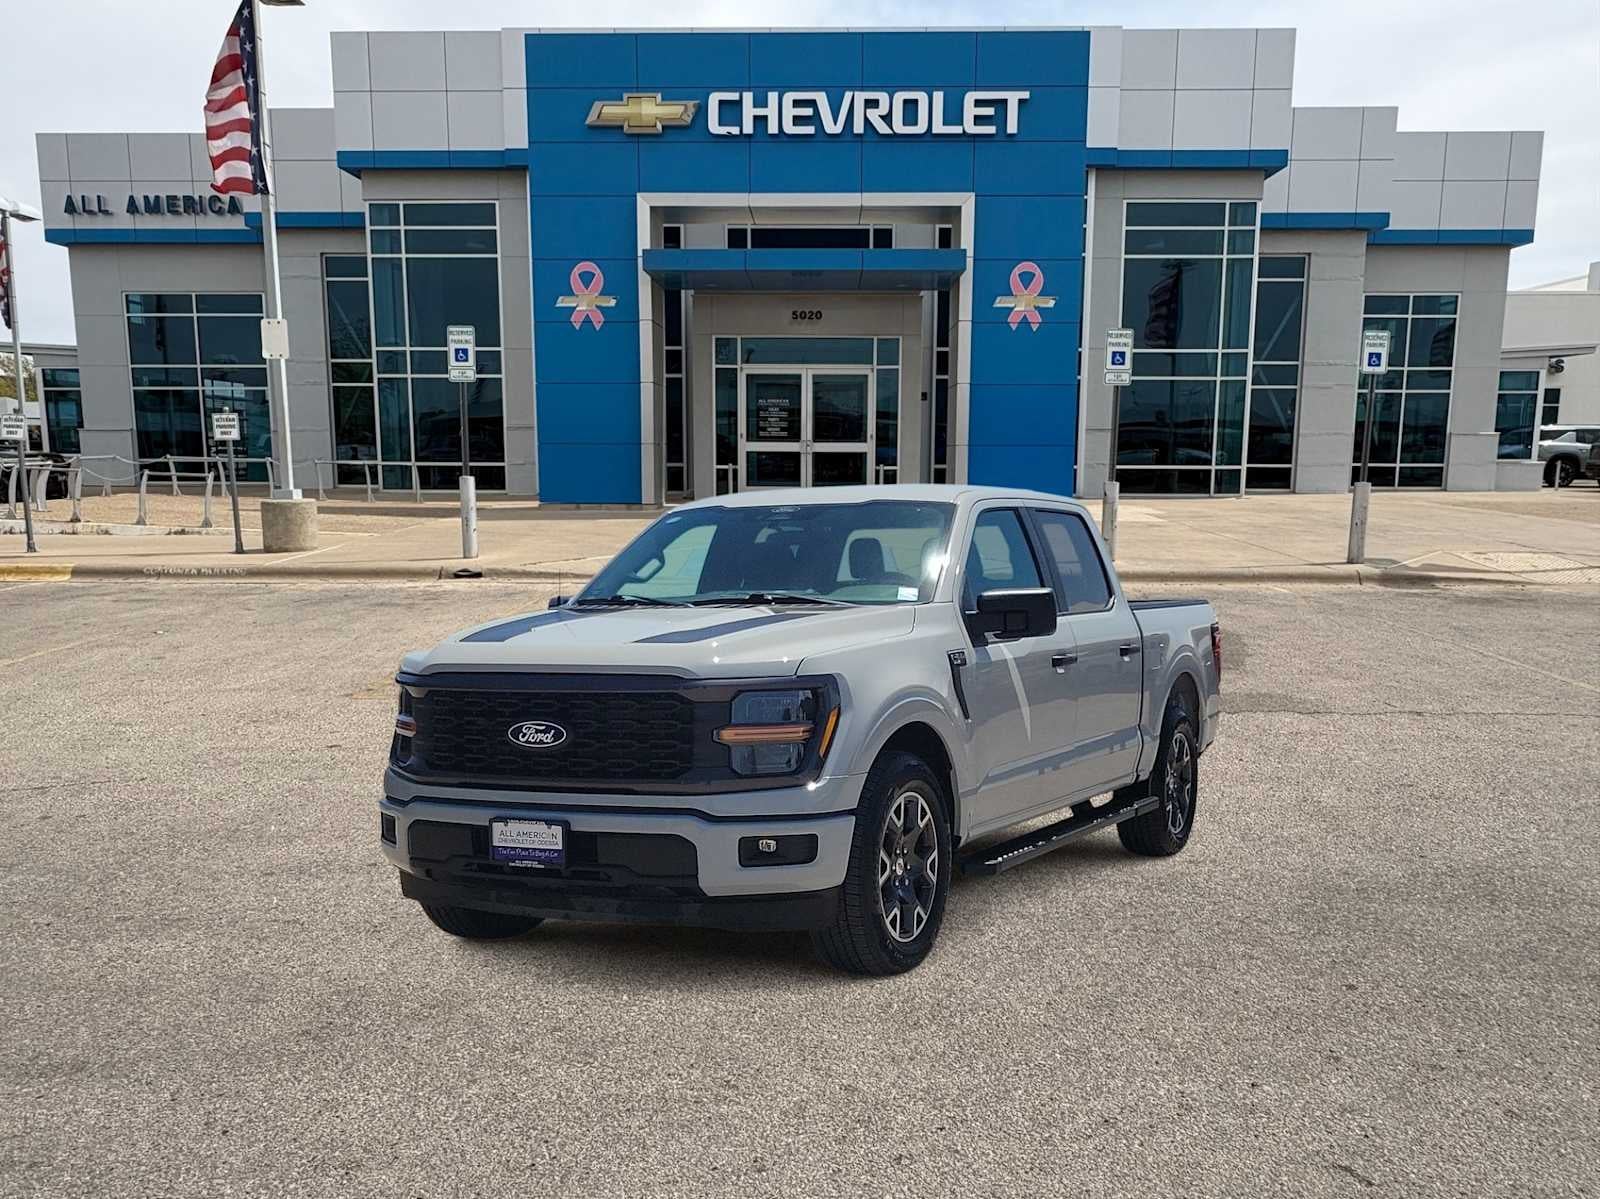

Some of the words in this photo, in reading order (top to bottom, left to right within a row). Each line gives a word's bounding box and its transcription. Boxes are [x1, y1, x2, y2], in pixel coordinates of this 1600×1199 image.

[707, 90, 1031, 136] CHEVROLET
[63, 194, 113, 215] ALL
[791, 310, 823, 321] 5020
[519, 724, 556, 743] Ford
[499, 829, 515, 838] ALL
[516, 831, 558, 841] AMERICN
